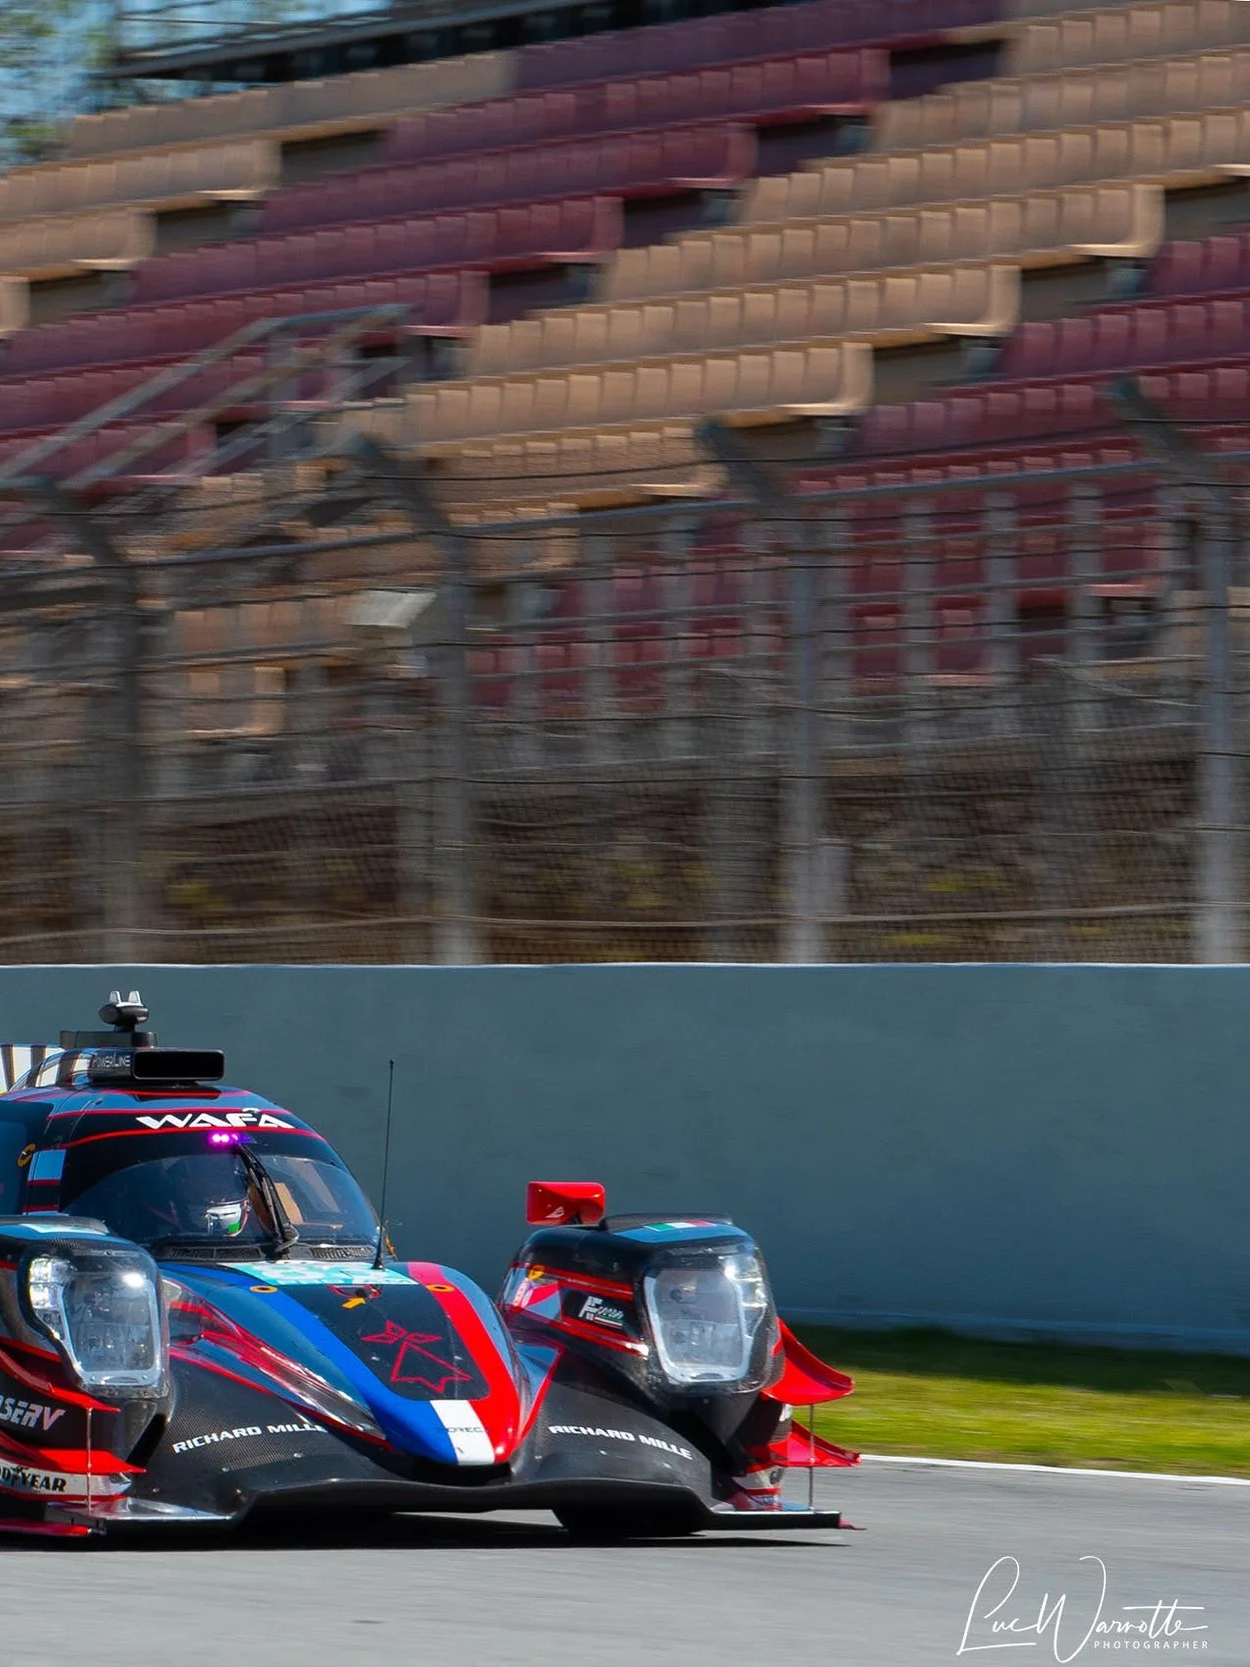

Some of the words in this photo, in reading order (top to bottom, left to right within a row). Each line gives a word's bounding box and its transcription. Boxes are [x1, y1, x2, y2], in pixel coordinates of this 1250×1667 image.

[136, 1111, 295, 1130] WAFA
[172, 1426, 262, 1454] RICHARD
[548, 1425, 636, 1441] RICHARD
[638, 1434, 693, 1461] MILLE
